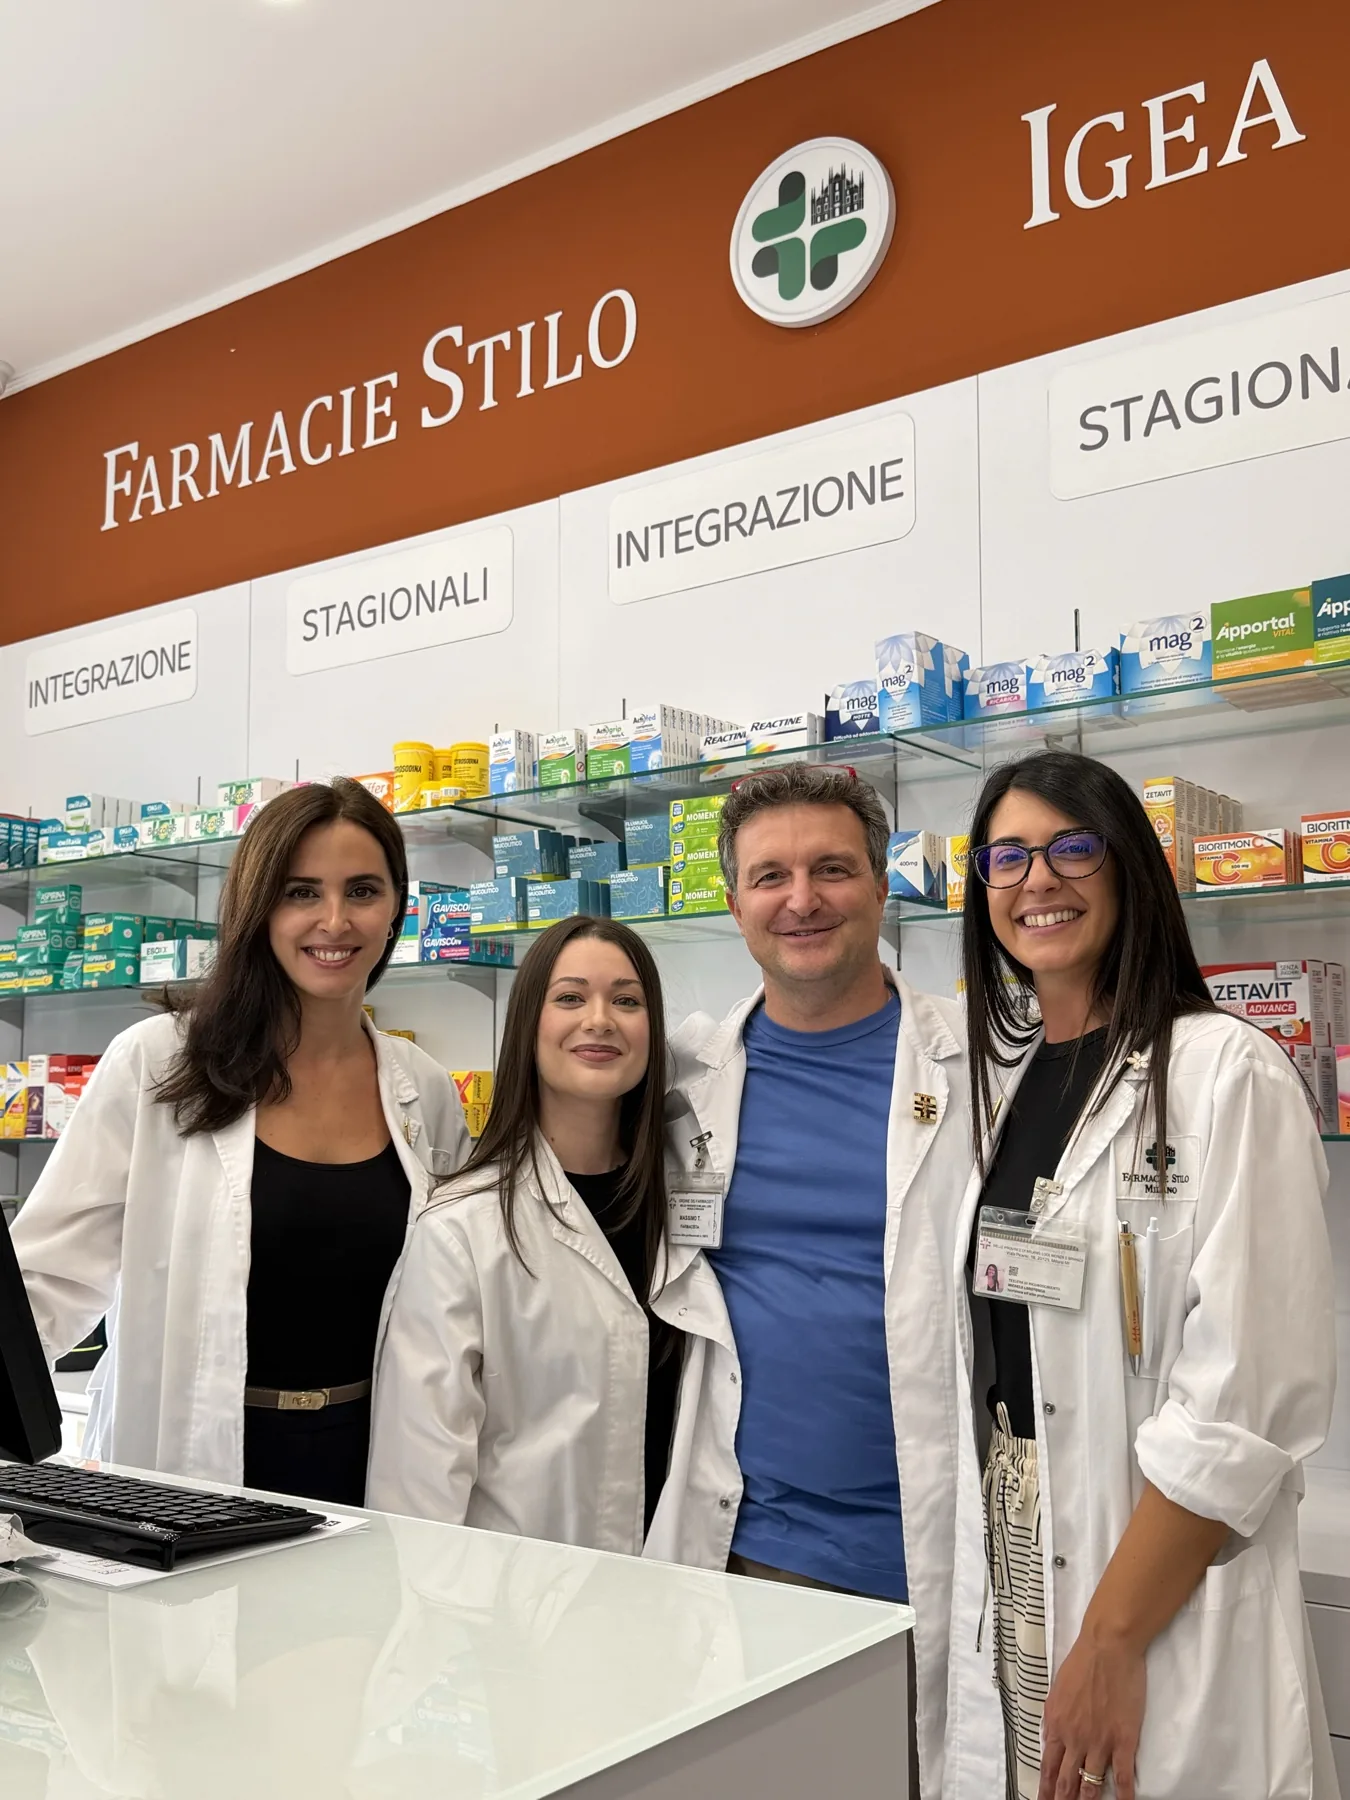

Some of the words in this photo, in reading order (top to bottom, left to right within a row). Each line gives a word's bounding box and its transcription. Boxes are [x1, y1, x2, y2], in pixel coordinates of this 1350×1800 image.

[1020, 57, 1307, 231] IGEA
[1079, 346, 1350, 452] STAGION
[100, 370, 399, 532] FARMACIE
[420, 288, 638, 429] STILO
[615, 457, 906, 570] INTEGRAZIONE
[301, 566, 490, 643] STAGIONALI
[1148, 631, 1193, 652] mag
[1192, 617, 1205, 631] 2
[1215, 611, 1296, 642] Apportal
[1272, 629, 1296, 638] VITAL
[28, 639, 192, 709] INTEGRAZIONE
[881, 673, 907, 688] mag
[1051, 666, 1086, 683] mag
[986, 676, 1020, 694] mag
[846, 694, 878, 711] mag
[750, 715, 803, 732] REACTINE
[1146, 789, 1172, 799] ZETAVIT
[686, 810, 720, 822] MOMENT
[1198, 840, 1251, 852] BIORITMON
[1305, 837, 1333, 845] VITAMINA
[687, 850, 719, 861] MOMENT
[686, 890, 718, 900] MOMENT
[424, 937, 462, 948] GAVISCON
[1212, 982, 1293, 1001] ZETAVIT
[1248, 1003, 1296, 1014] ADVANCE
[1122, 1172, 1169, 1182] FARMAC
[1171, 1173, 1190, 1184] STILO
[1144, 1184, 1178, 1194] MILNO
